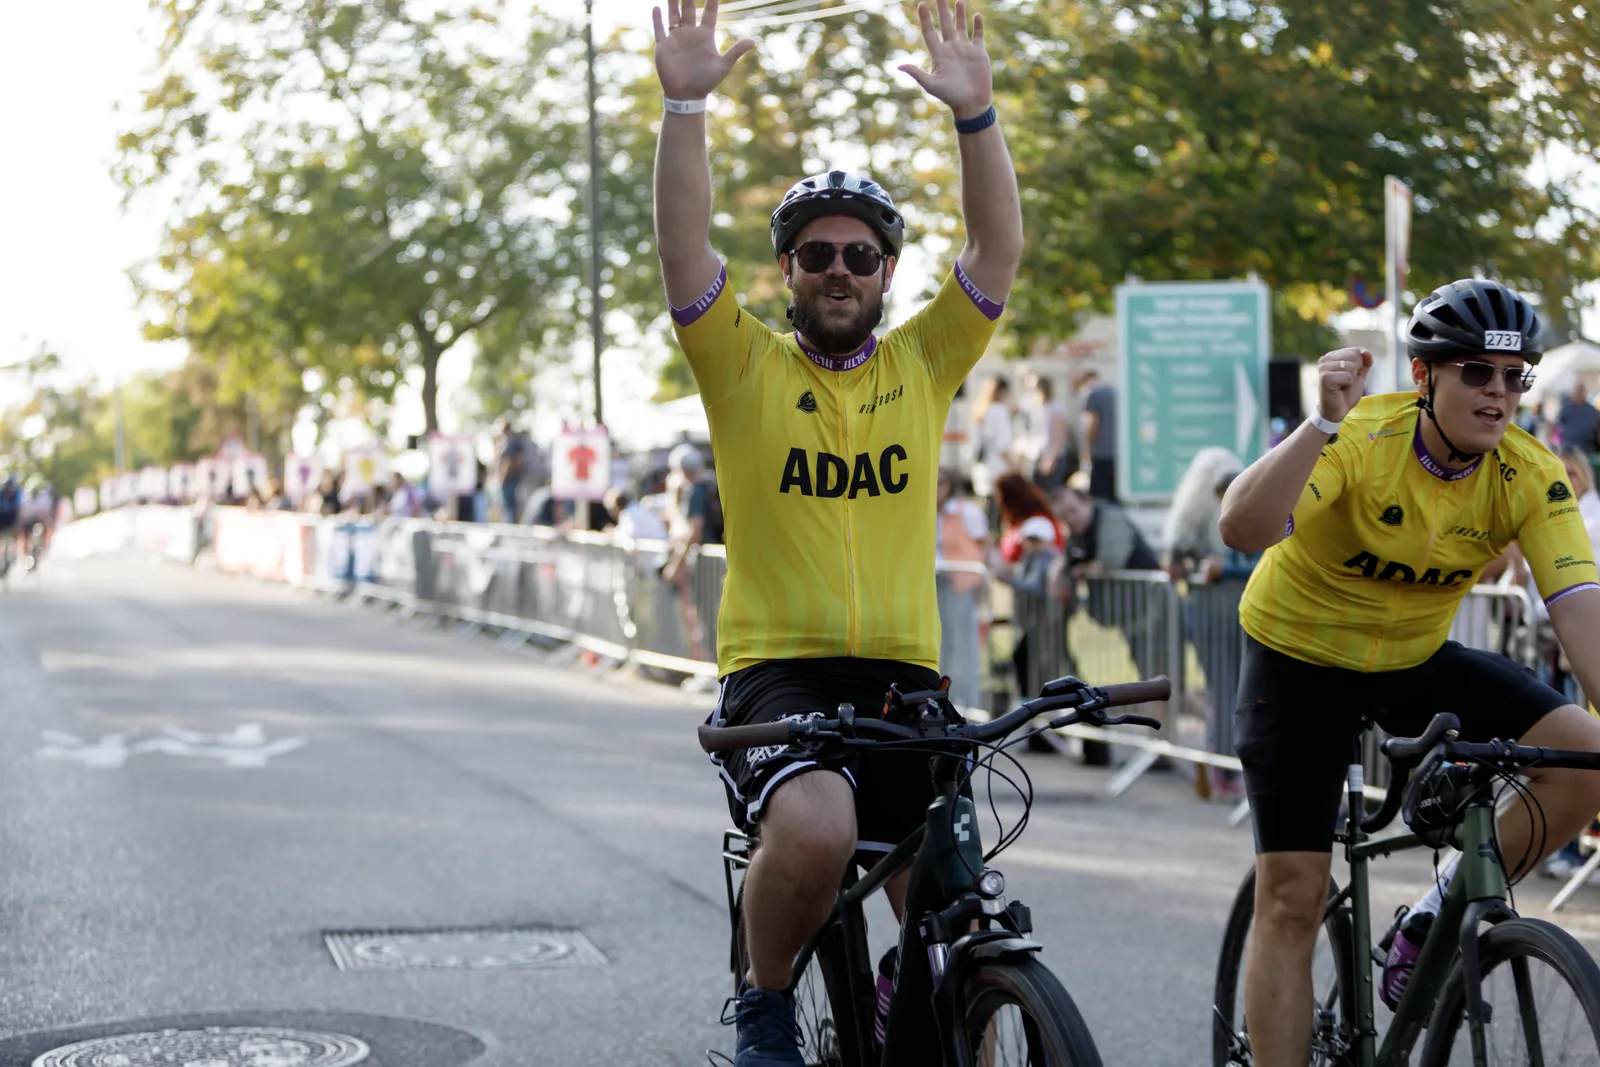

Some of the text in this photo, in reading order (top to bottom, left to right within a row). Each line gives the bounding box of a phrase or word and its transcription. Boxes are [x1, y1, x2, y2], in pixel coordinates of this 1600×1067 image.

[1485, 333, 1520, 347] 2737
[780, 444, 908, 499] ADAC
[1308, 482, 1322, 501] ADAC
[1343, 550, 1474, 587] ADAC
